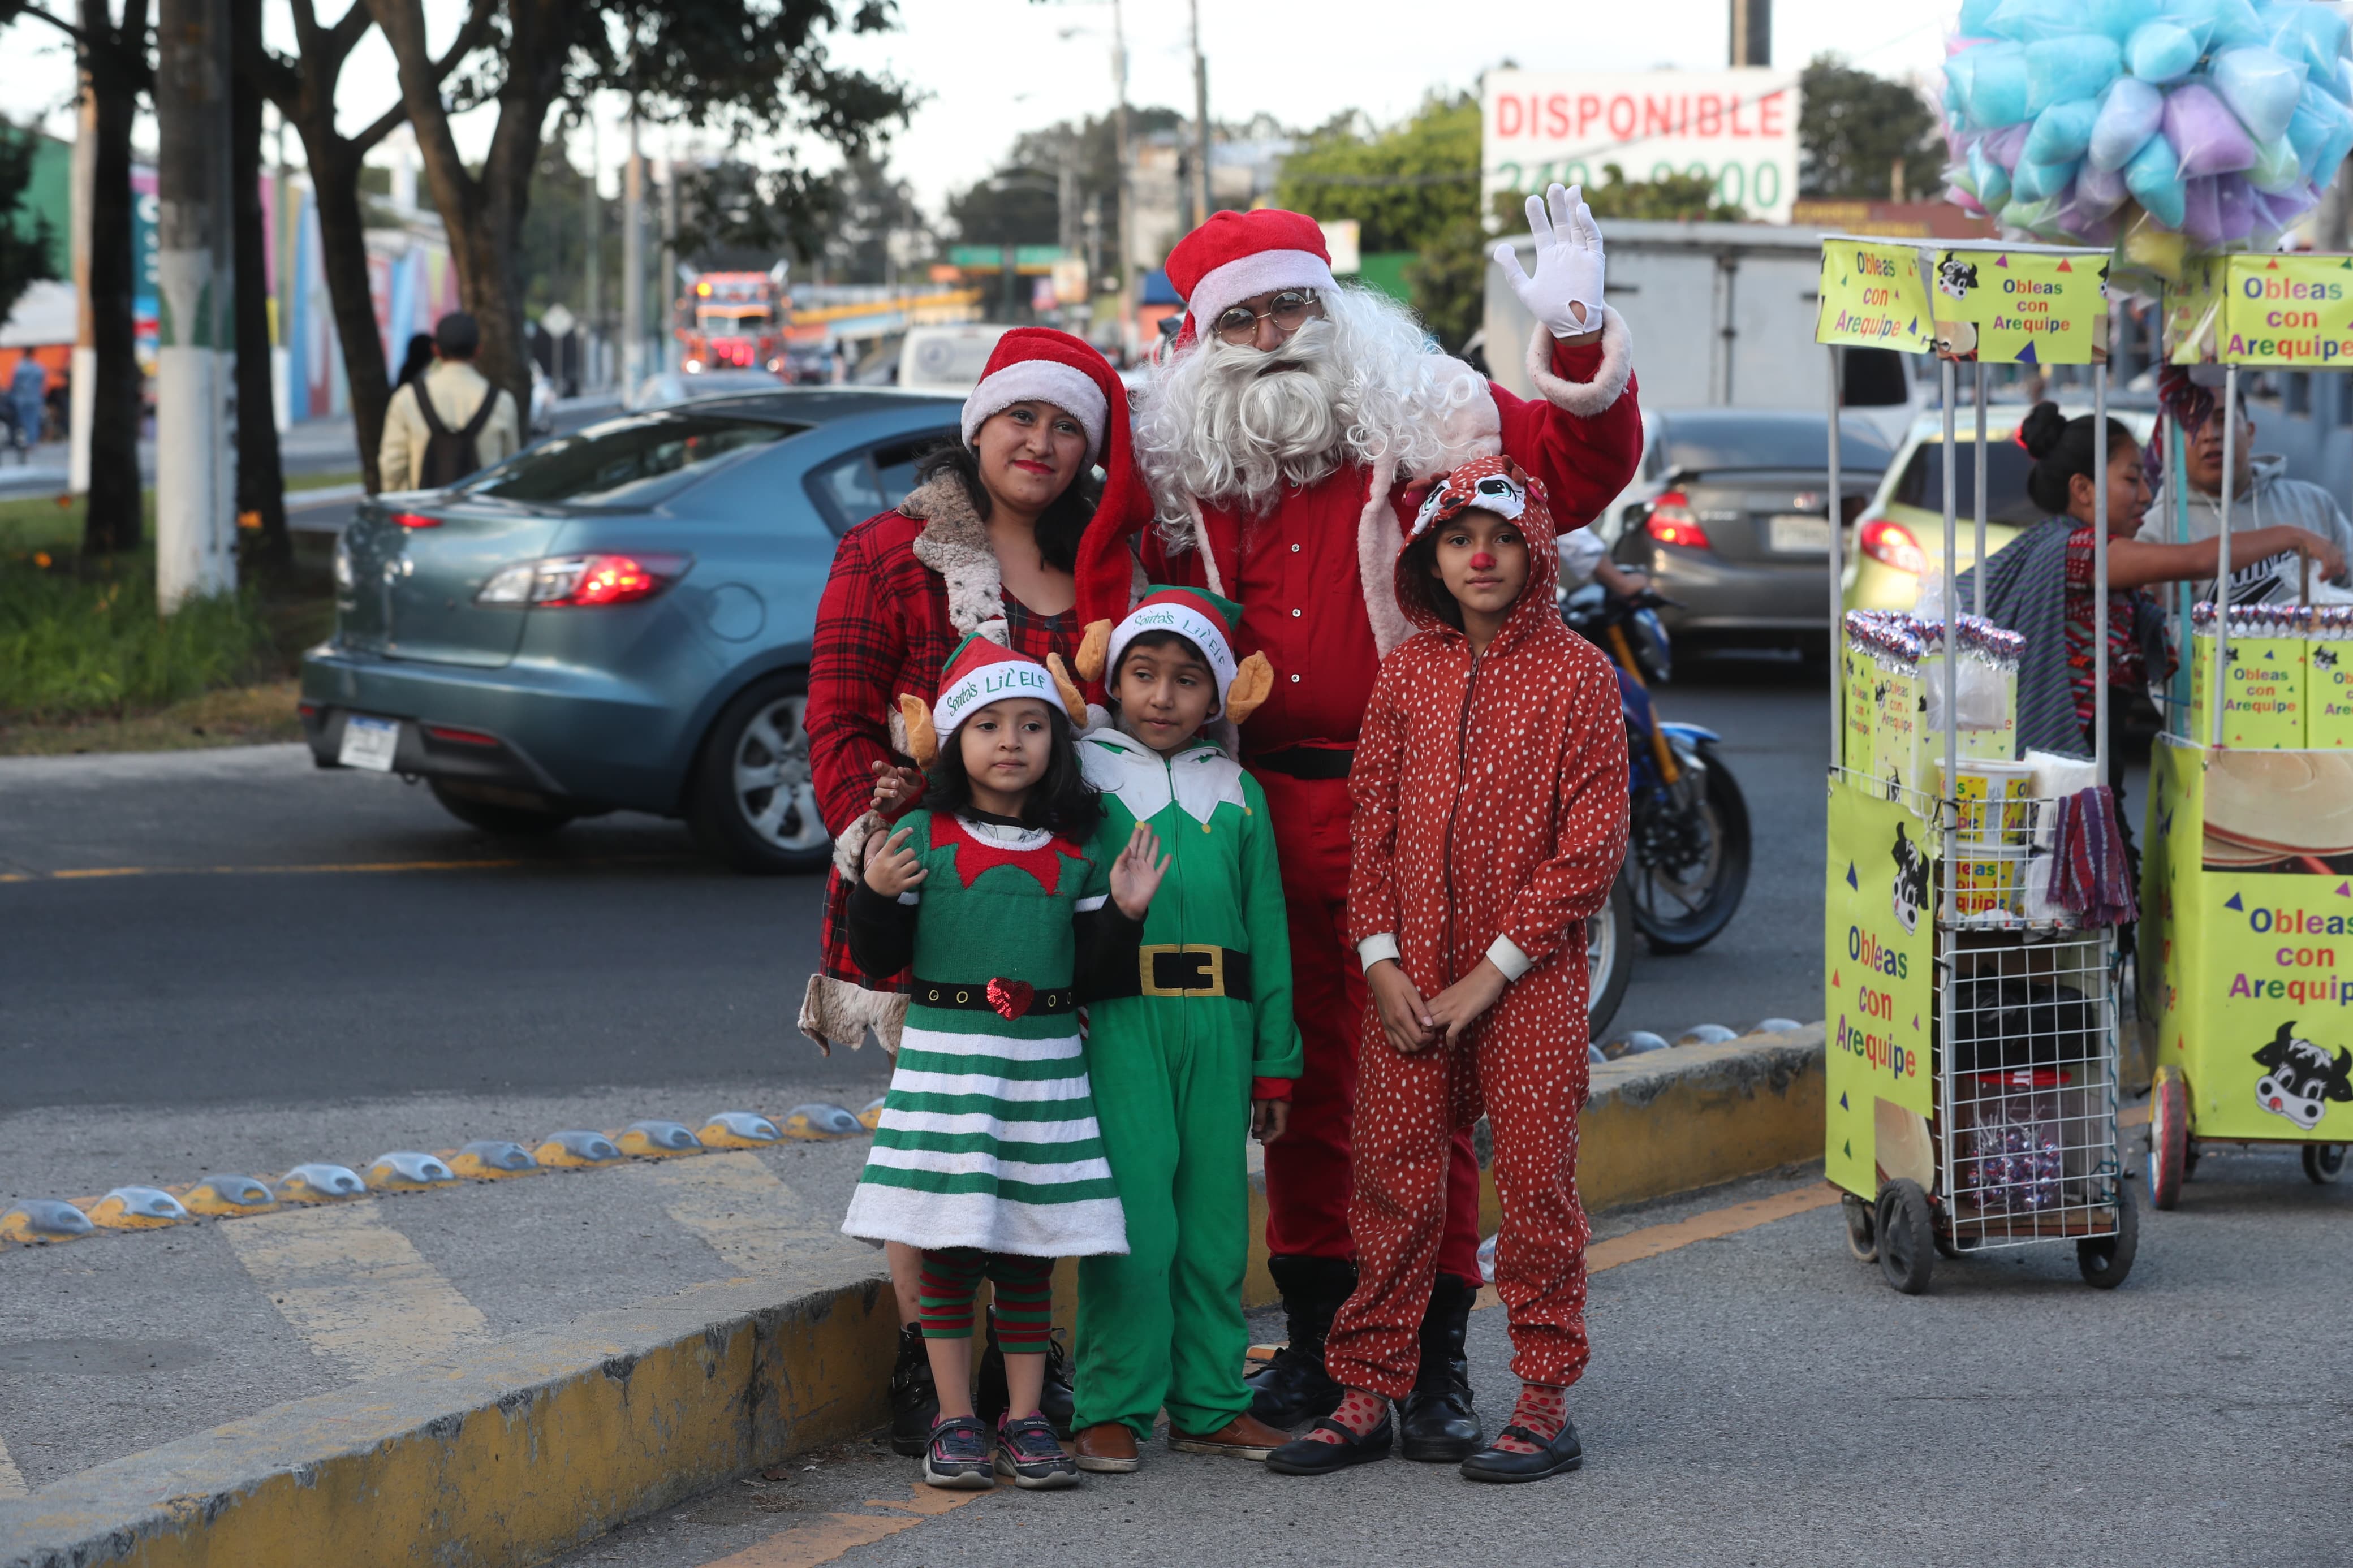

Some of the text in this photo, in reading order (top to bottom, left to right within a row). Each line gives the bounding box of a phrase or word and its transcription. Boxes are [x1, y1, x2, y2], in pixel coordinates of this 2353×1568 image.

[1498, 92, 1785, 139] DISPONIBLE
[1857, 251, 1895, 277] Obleas
[1863, 286, 1888, 306] con
[2003, 279, 2062, 295] Obleas
[2244, 278, 2343, 299] Obleas
[2017, 300, 2048, 312] con
[1835, 310, 1902, 339] Arequipe
[1993, 316, 2070, 333] Arequipe
[2267, 310, 2318, 328] con
[2227, 334, 2353, 361] Arequipe
[1135, 611, 1174, 626] Santa's
[2234, 668, 2289, 681] Obleas
[947, 682, 978, 717] Santa's
[1020, 671, 1046, 689] ELF
[1885, 679, 1909, 698] Obleas
[2246, 685, 2276, 697] con
[2225, 699, 2296, 714] Arequipe
[1882, 711, 1913, 733] Arequipe
[1849, 925, 1908, 979] Obleas
[2276, 947, 2334, 967] con
[1859, 986, 1893, 1021] con
[1836, 1013, 1916, 1079] Arequipe
